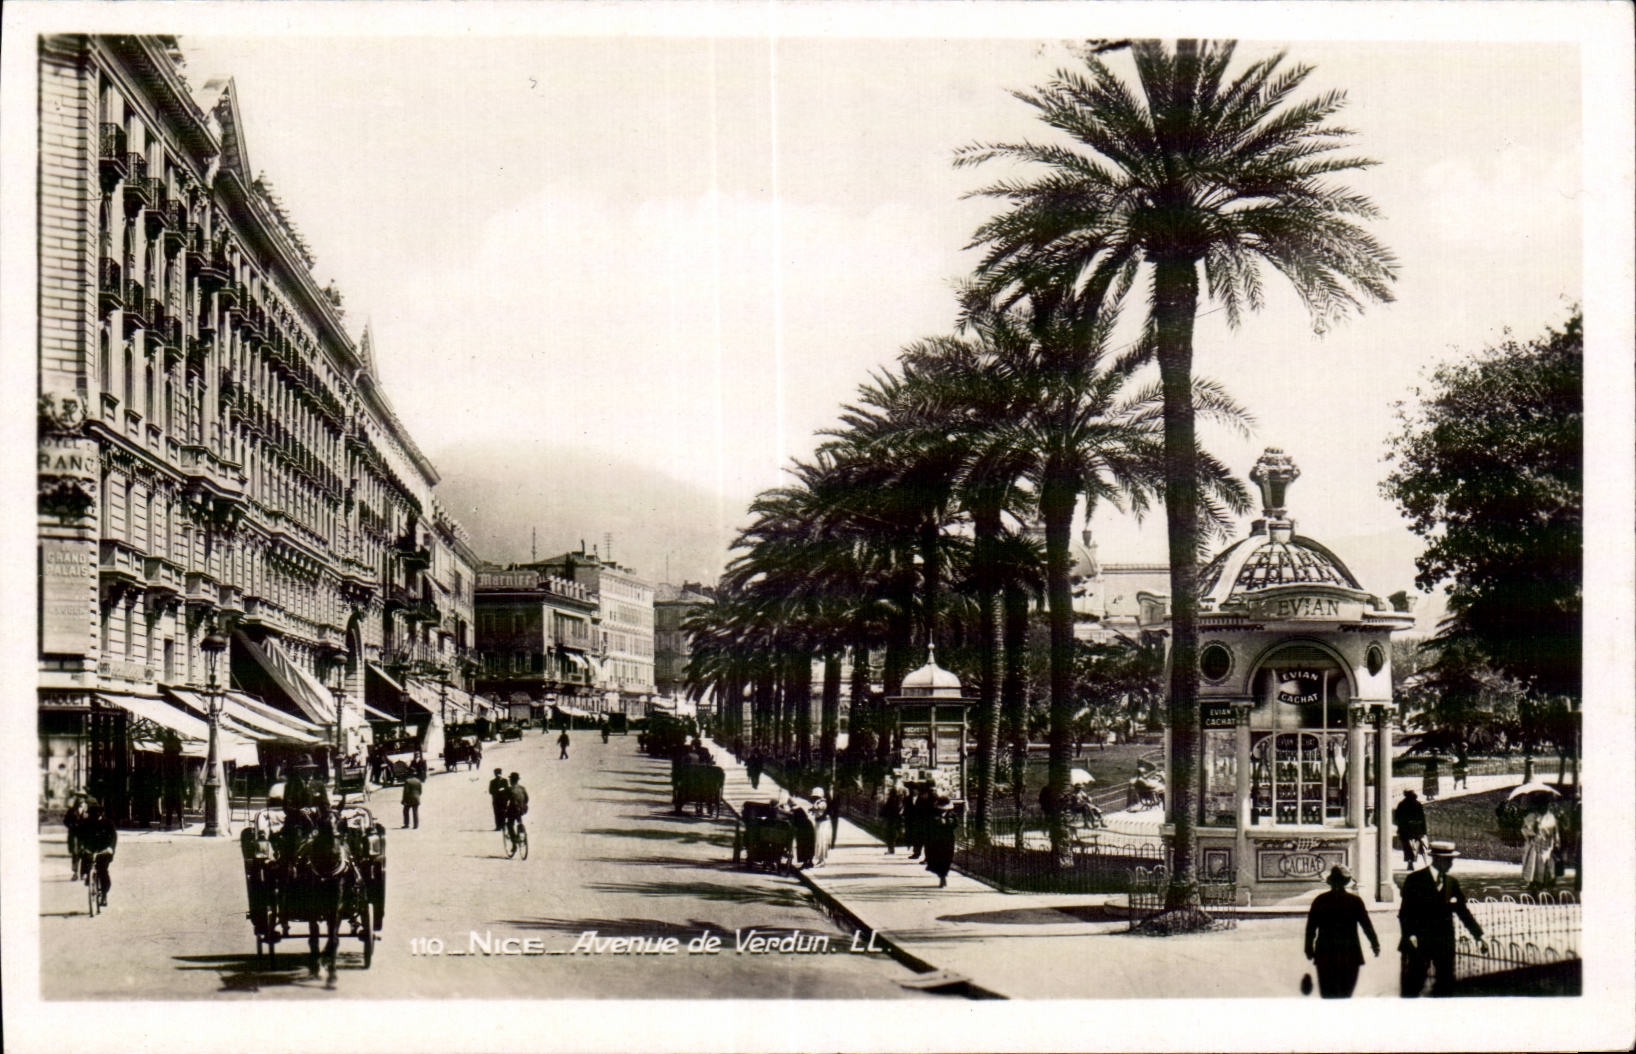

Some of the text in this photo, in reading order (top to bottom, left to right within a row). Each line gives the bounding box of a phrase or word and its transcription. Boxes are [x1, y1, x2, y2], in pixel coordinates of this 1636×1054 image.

[47, 551, 86, 565] GRAND
[1276, 598, 1340, 616] EVIAN
[1282, 671, 1319, 681] EVIAN
[1281, 693, 1318, 704] CACHAT
[1210, 708, 1231, 716] EVIAN
[1205, 718, 1236, 726] CACHAT
